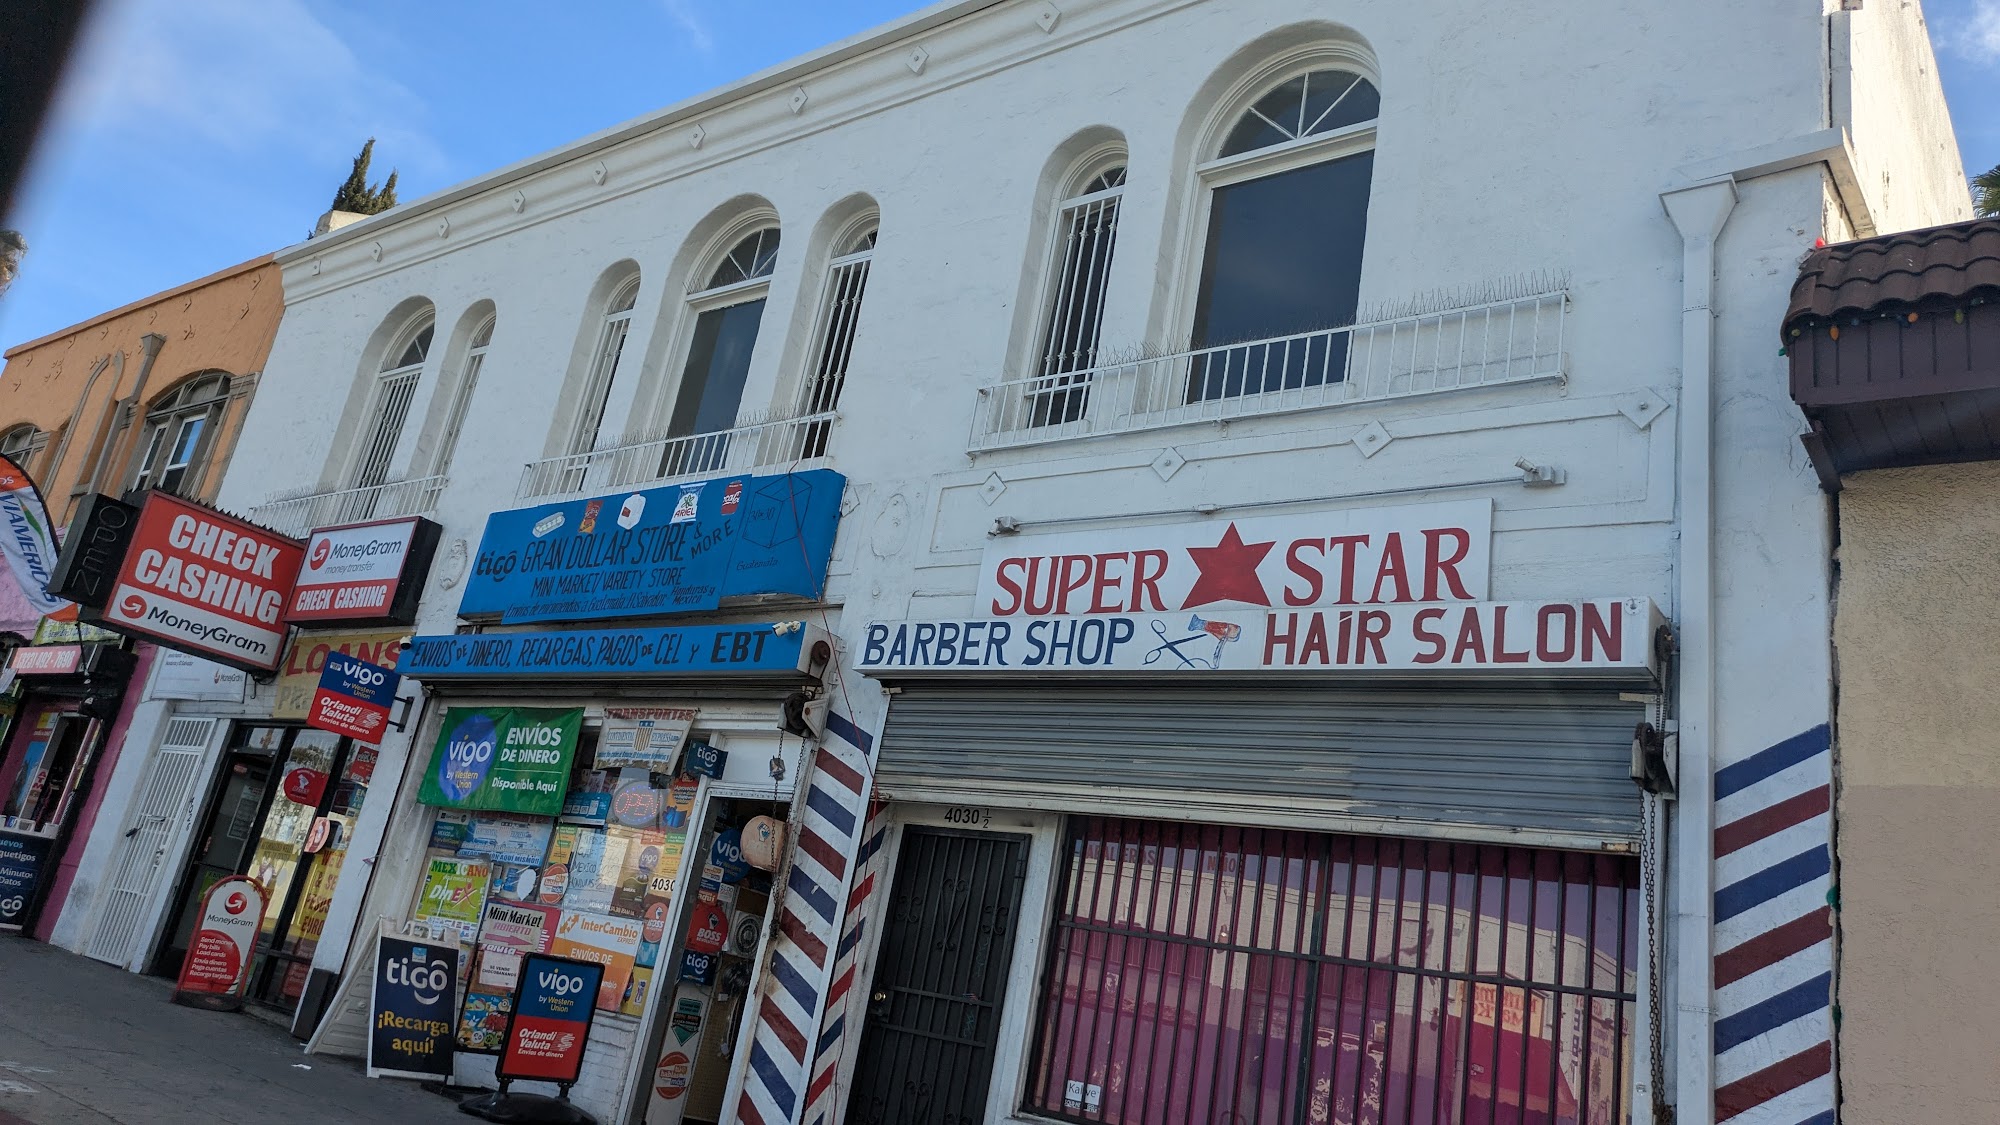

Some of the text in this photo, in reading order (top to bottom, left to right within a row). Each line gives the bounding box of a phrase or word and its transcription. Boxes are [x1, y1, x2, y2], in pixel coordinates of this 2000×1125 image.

[169, 514, 281, 580] CHECK
[330, 539, 401, 561] MoneyGram
[521, 536, 568, 573] GRAN
[566, 527, 632, 570] DOLLAR
[631, 522, 694, 565] STORE
[691, 518, 735, 560] MORE
[325, 561, 375, 575] money transfer
[991, 527, 1476, 615] SUPER STAR
[135, 548, 282, 625] CASHING
[531, 576, 554, 598] MINI
[649, 566, 686, 588] STORE
[296, 585, 388, 611] CHECK CASHING
[147, 606, 267, 655] MoneyGram
[860, 620, 1012, 665] BARBER
[1021, 617, 1135, 665] SHOP
[1411, 602, 1623, 664] SALON
[410, 640, 457, 668] ENVIOS
[516, 635, 594, 667] RECARGAS,
[595, 634, 641, 667] PAGOS
[653, 632, 683, 665] CEL
[710, 630, 774, 664] EBT
[343, 661, 385, 686] vigo
[343, 680, 376, 696] by Western
[353, 689, 371, 699] Union
[320, 696, 363, 716] Orlandi
[320, 706, 356, 724] Valuta
[606, 707, 695, 721] TRANSPORTES
[340, 720, 349, 728] de
[350, 723, 370, 735] dinero
[505, 722, 563, 747] ENVÍOS
[450, 734, 493, 768] vigo
[500, 748, 561, 765] DE DINERO
[446, 769, 479, 780] by Western
[456, 779, 472, 789] Union
[492, 776, 558, 795] Disponible Aquí
[615, 792, 660, 817] OPEN
[944, 807, 979, 825] 4030
[430, 861, 488, 878] MEXICANO
[206, 914, 254, 927] MoneyGram
[487, 906, 543, 928] Mini Market
[493, 923, 532, 936] ABIERTO
[581, 918, 638, 939] InterCambio
[697, 927, 722, 942] BOSS
[198, 943, 208, 952] Pay
[201, 936, 234, 948] Send money
[197, 949, 211, 957] Load
[570, 947, 613, 965] ENVÍOS DE
[538, 968, 584, 995] vigo
[538, 994, 574, 1006] by Western
[550, 1004, 569, 1013] Union
[377, 1010, 449, 1037] ¡Recarga
[519, 1028, 557, 1041] Orlandi
[392, 1037, 435, 1056] aquí!
[519, 1038, 551, 1050] Valuta
[546, 1049, 564, 1058] dinero
